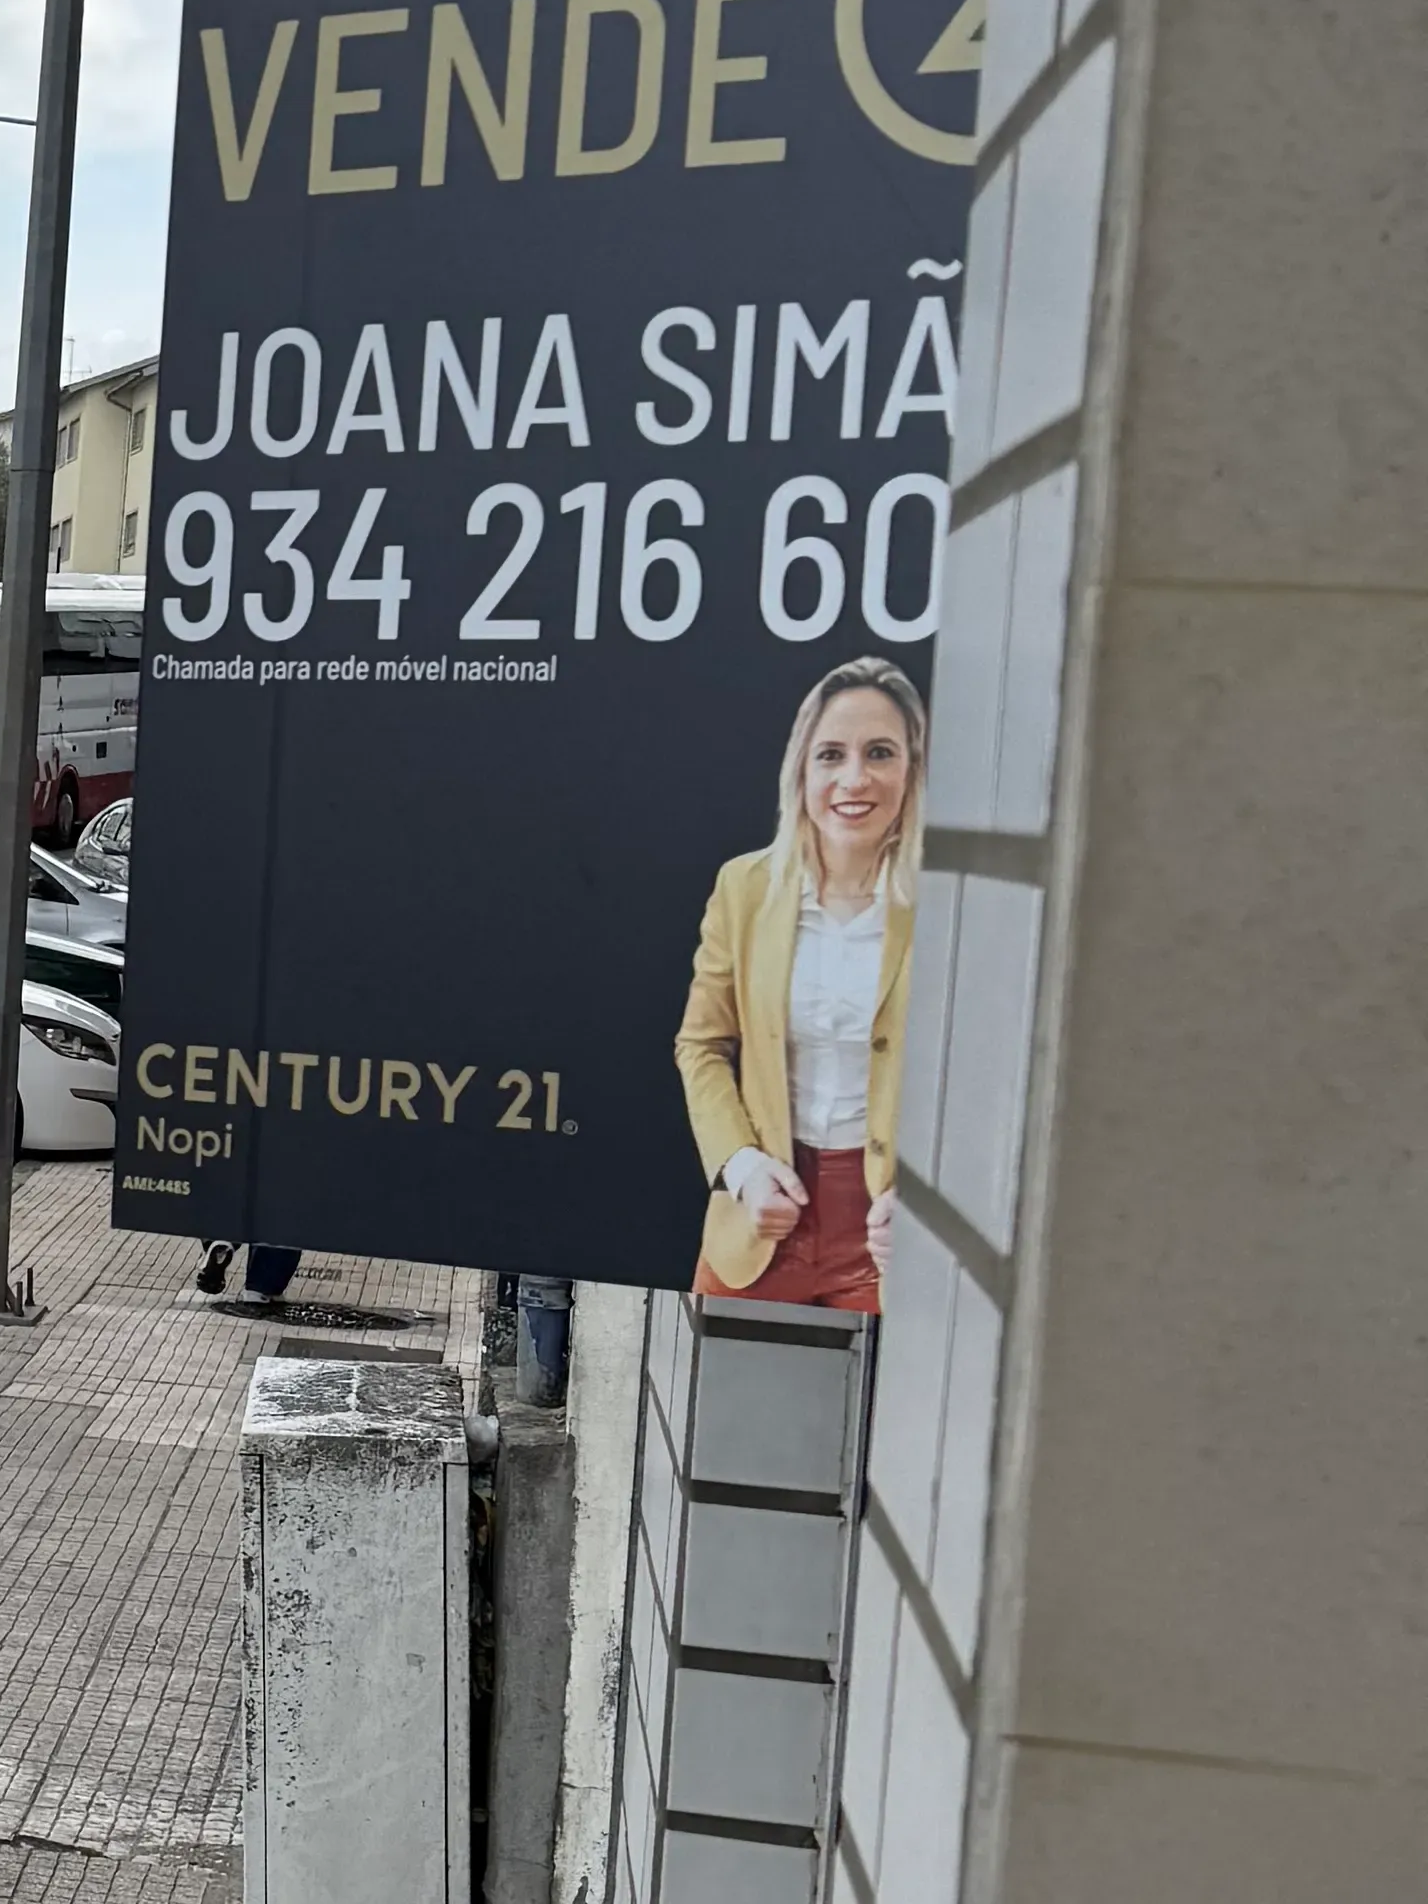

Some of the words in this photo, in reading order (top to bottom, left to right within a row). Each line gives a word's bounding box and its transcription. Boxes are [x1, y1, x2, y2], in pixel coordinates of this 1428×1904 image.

[169, 313, 590, 461] JOANA
[161, 487, 412, 644] 934
[459, 478, 706, 642] 216
[152, 654, 254, 680] Chamada
[260, 658, 311, 686] para
[316, 655, 369, 681] rede
[375, 655, 447, 682] móvel
[453, 655, 557, 682] nacional
[136, 1042, 478, 1124] CENTURY
[137, 1116, 233, 1167] Nopi
